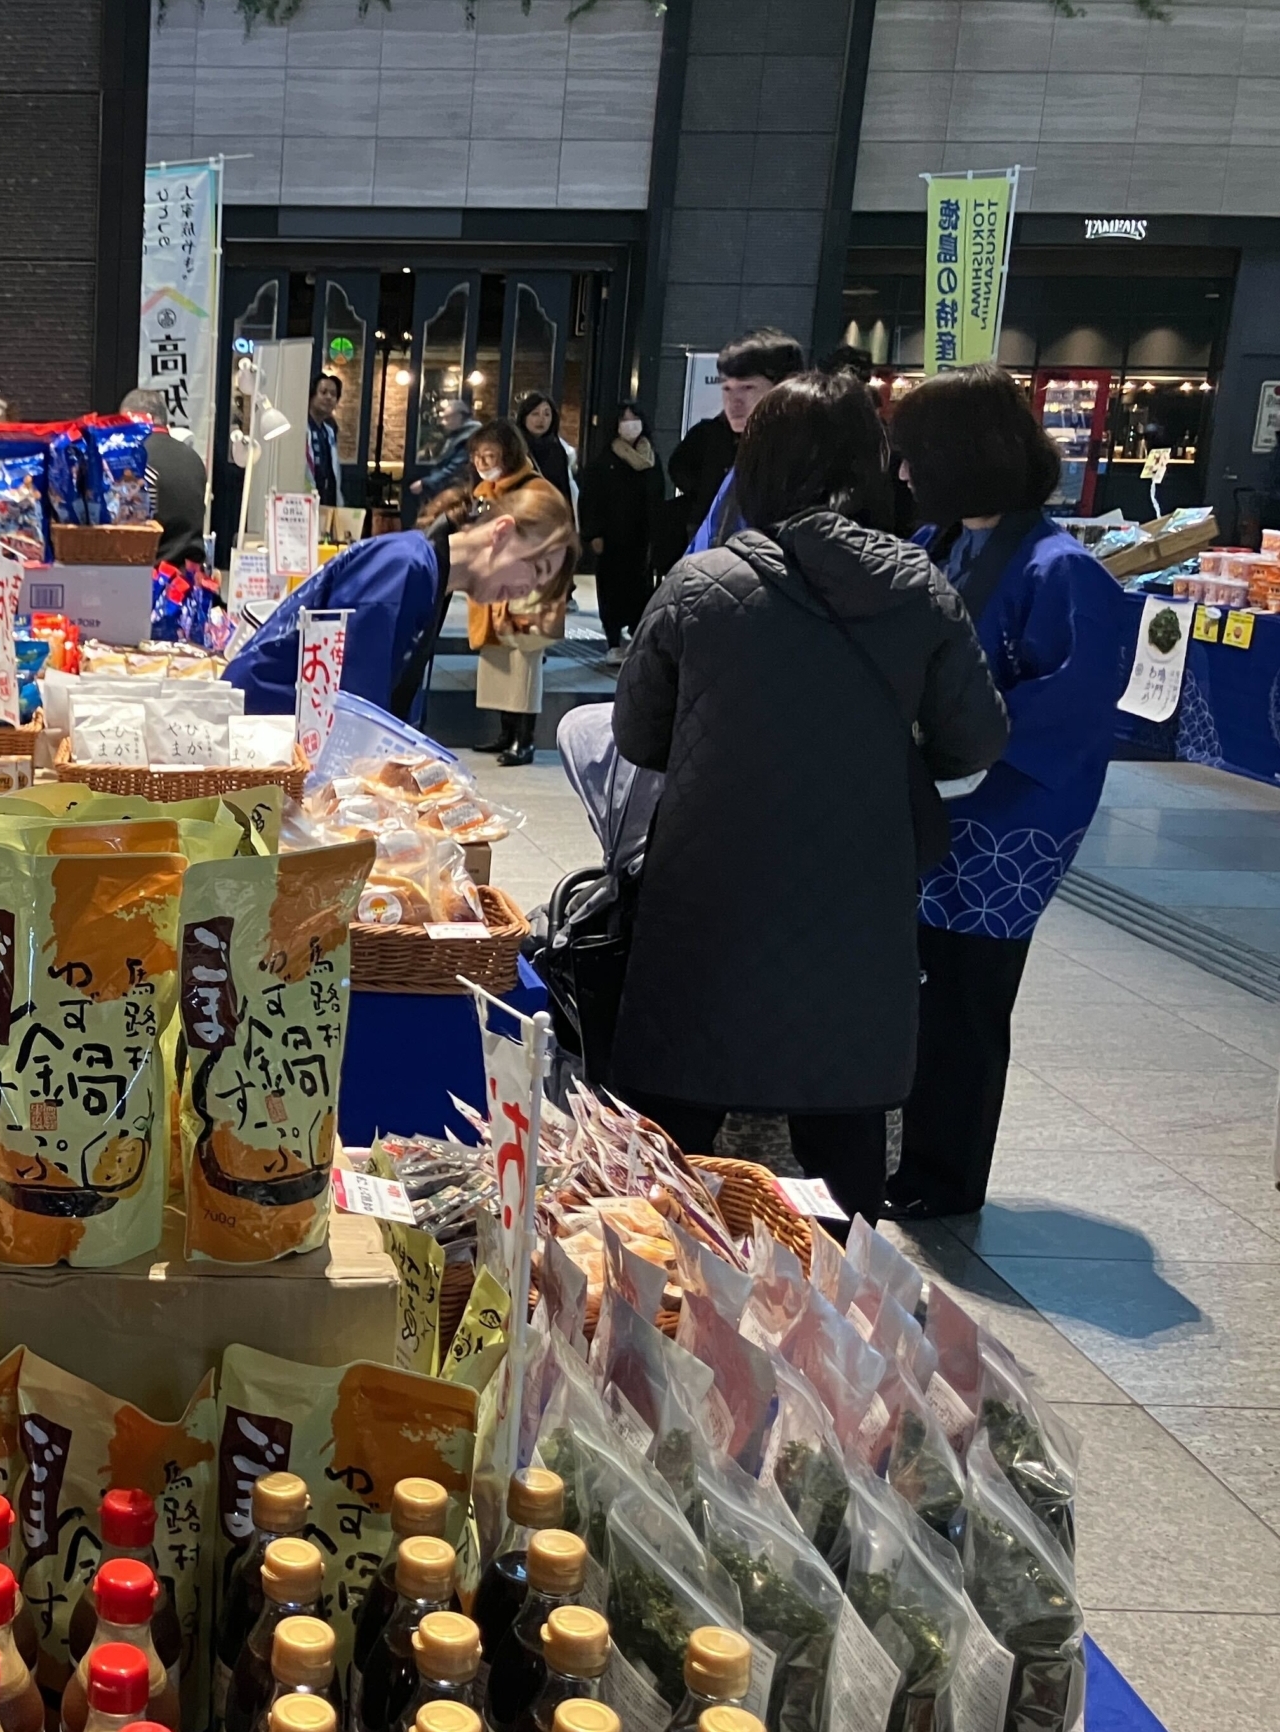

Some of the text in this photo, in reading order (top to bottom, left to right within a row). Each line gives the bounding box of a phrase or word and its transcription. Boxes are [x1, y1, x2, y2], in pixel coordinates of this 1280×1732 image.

[122, 958, 158, 1072] 馬路村
[191, 926, 228, 1045] ごま
[307, 935, 342, 1049] 馬路村
[164, 1460, 201, 1570] 馬路村
